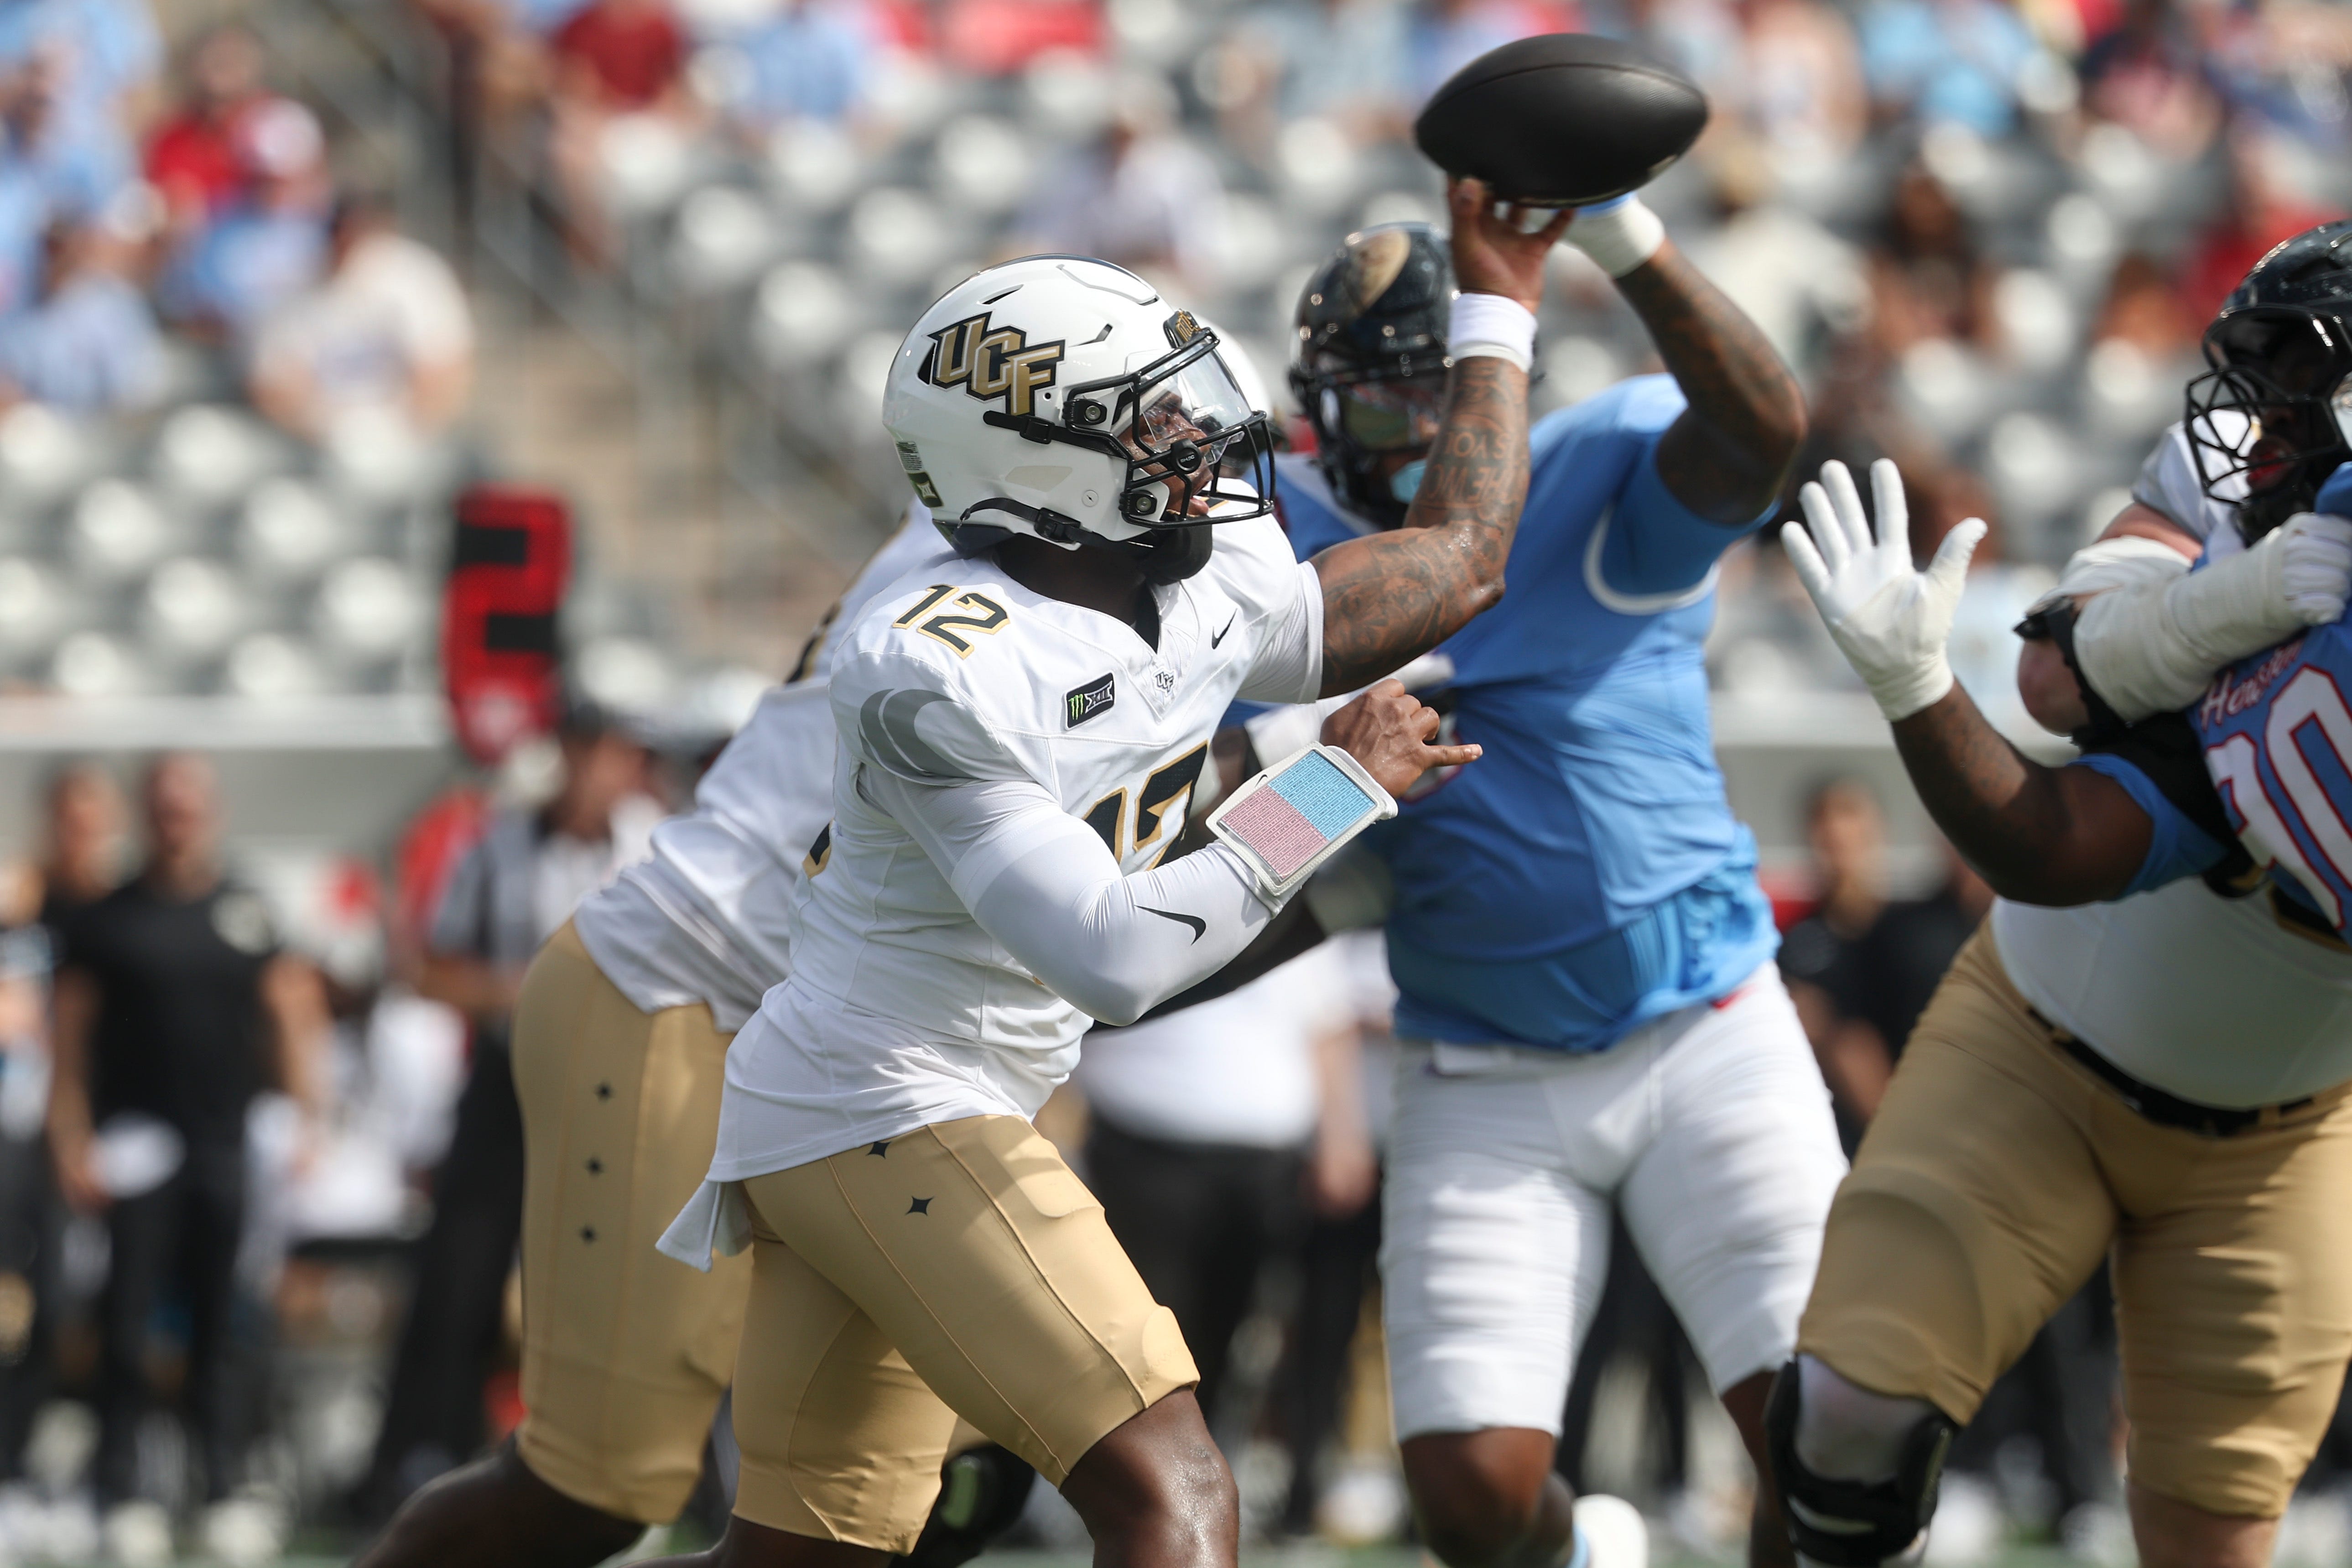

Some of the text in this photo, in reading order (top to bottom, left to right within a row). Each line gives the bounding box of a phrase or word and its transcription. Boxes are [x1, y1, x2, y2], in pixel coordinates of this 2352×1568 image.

[926, 311, 1066, 416] UCF
[892, 583, 1011, 661] 12
[1155, 671, 1174, 693] UCF
